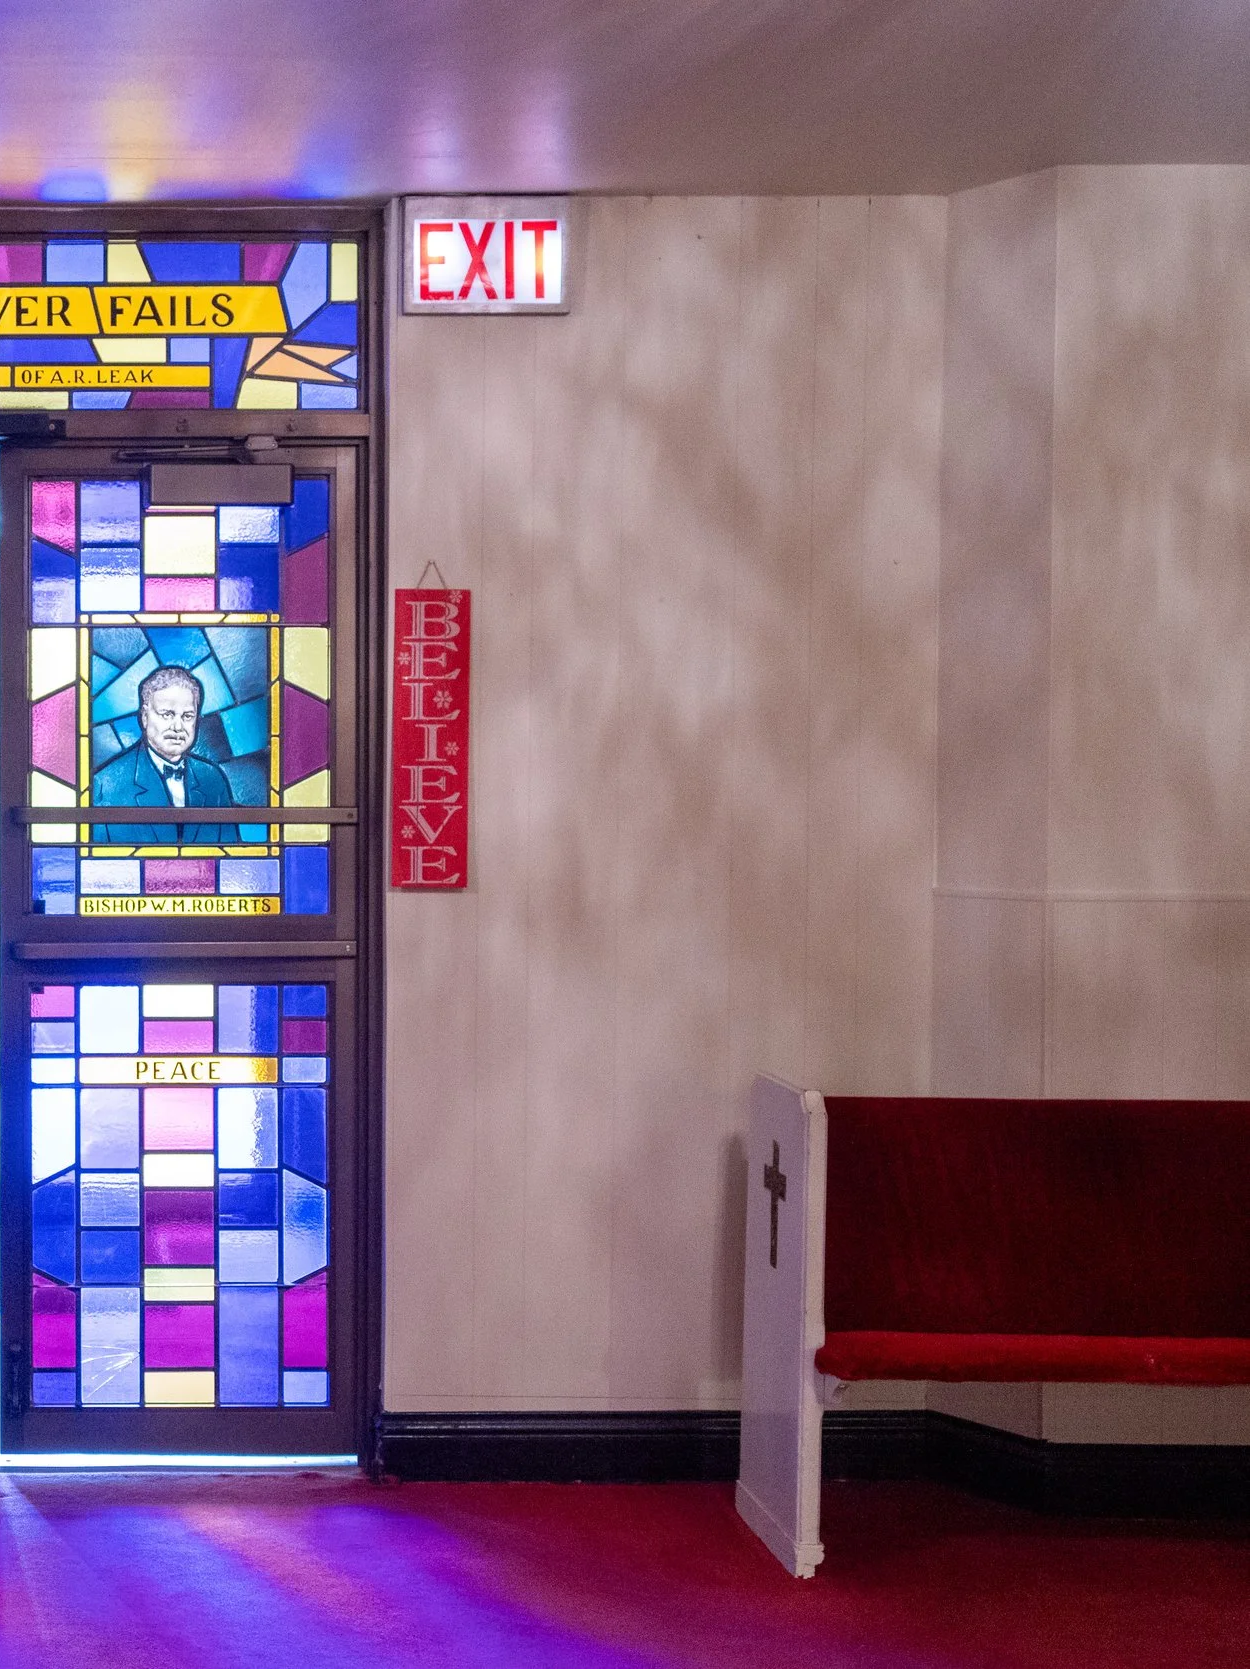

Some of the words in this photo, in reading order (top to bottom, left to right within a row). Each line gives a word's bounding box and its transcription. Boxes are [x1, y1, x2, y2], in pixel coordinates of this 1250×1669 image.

[419, 220, 558, 301] EXIT
[109, 293, 236, 328] FAILS
[21, 369, 45, 385] OF
[399, 600, 463, 885] BELIEVE
[83, 898, 147, 914] BISHOP
[135, 1060, 222, 1081] PEACE
